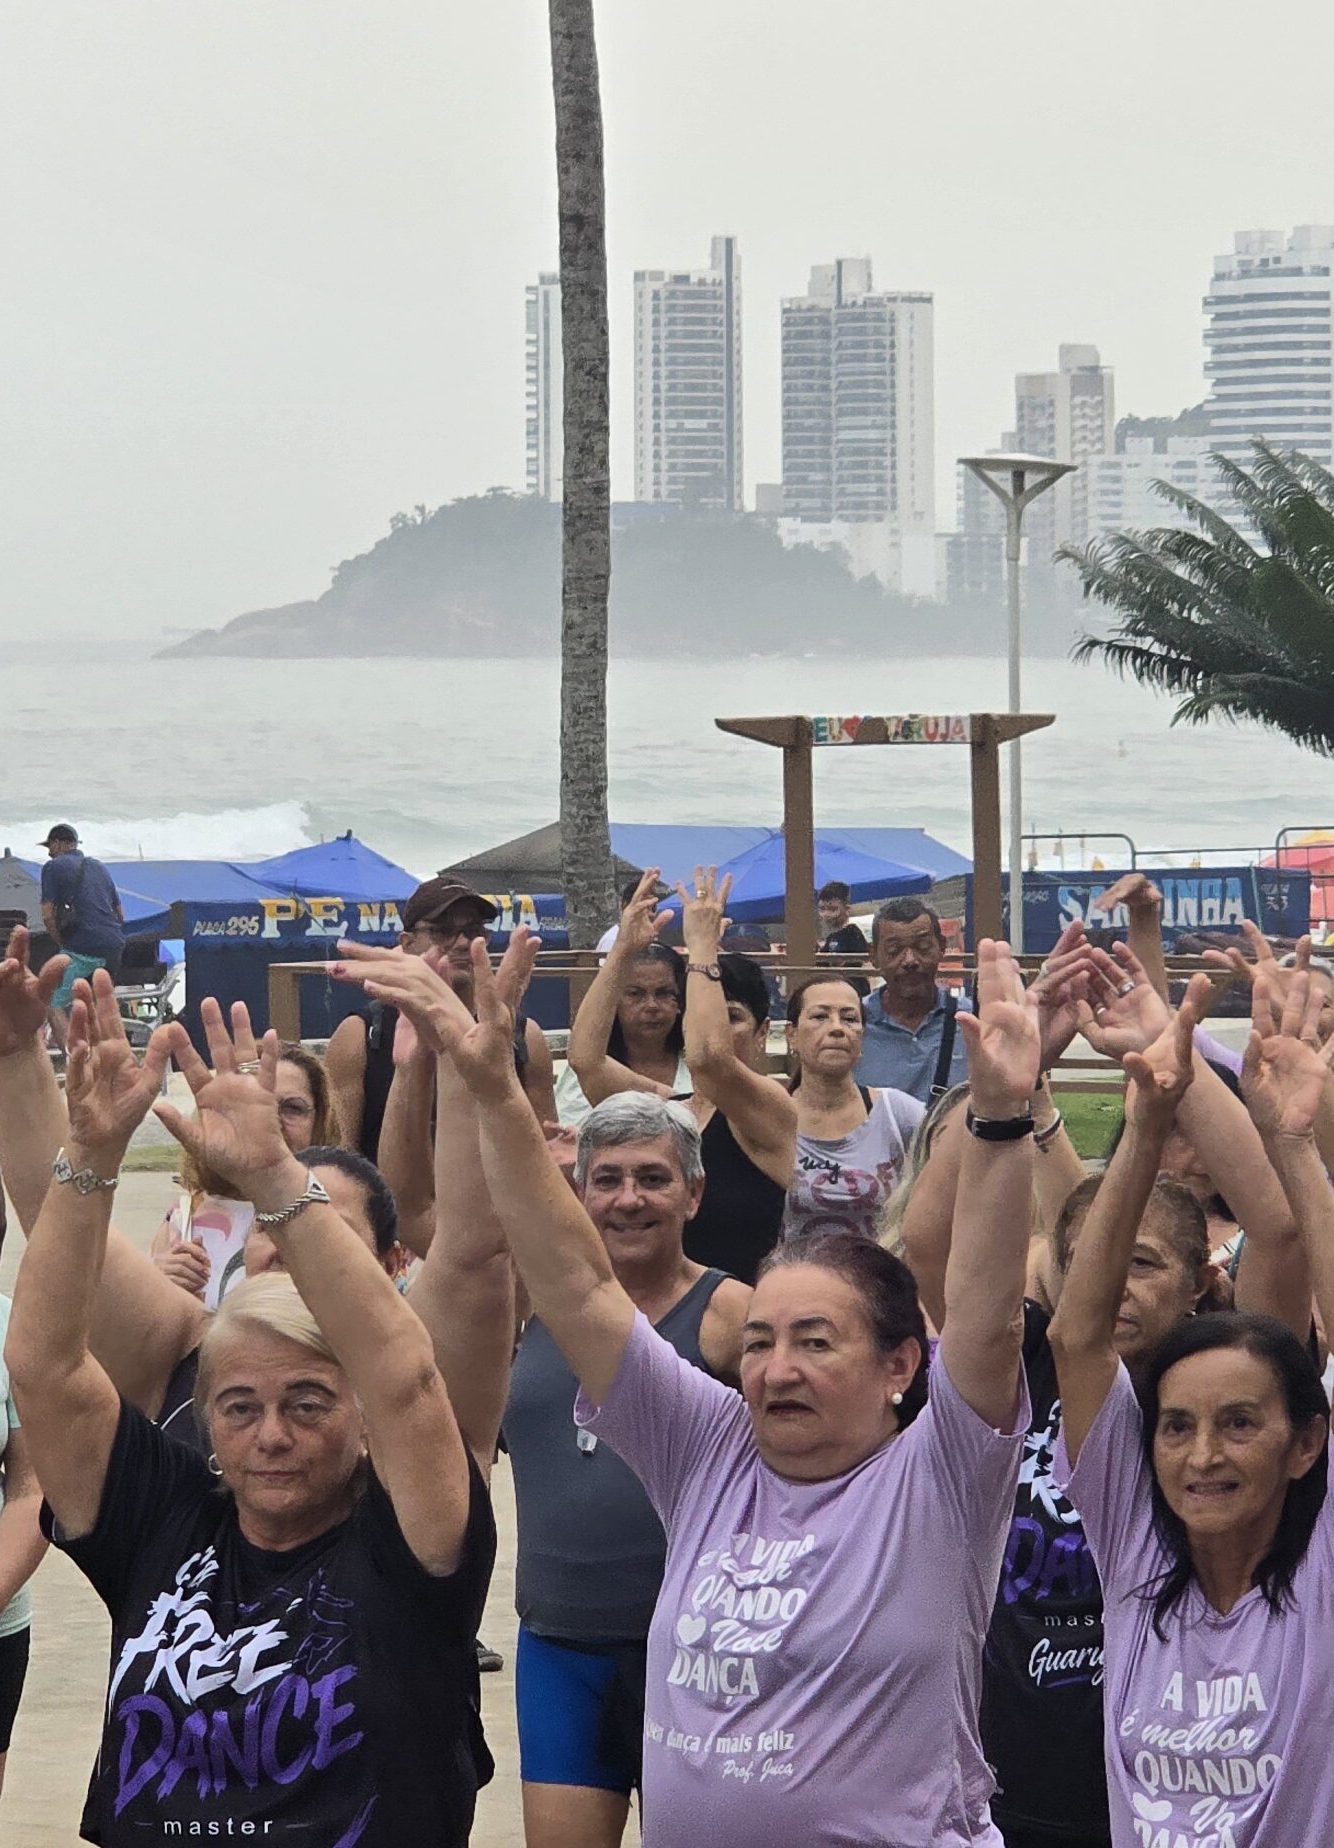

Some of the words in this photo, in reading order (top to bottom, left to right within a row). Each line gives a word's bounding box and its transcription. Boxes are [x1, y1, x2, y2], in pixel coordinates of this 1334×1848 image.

[259, 897, 348, 938] PE
[358, 903, 405, 932] NA
[1057, 877, 1246, 931] SAINHA
[225, 916, 259, 936] 295
[1044, 1612, 1104, 1627] mas
[108, 1587, 293, 1720] FREE
[1160, 1671, 1184, 1712] A
[1196, 1671, 1268, 1719] VIDA
[114, 1664, 365, 1817] DANCE
[716, 1733, 753, 1754] mais
[757, 1730, 795, 1752] feliz
[1142, 1715, 1256, 1755] melhor
[1134, 1750, 1285, 1797] QUANDO
[163, 1817, 273, 1836] master
